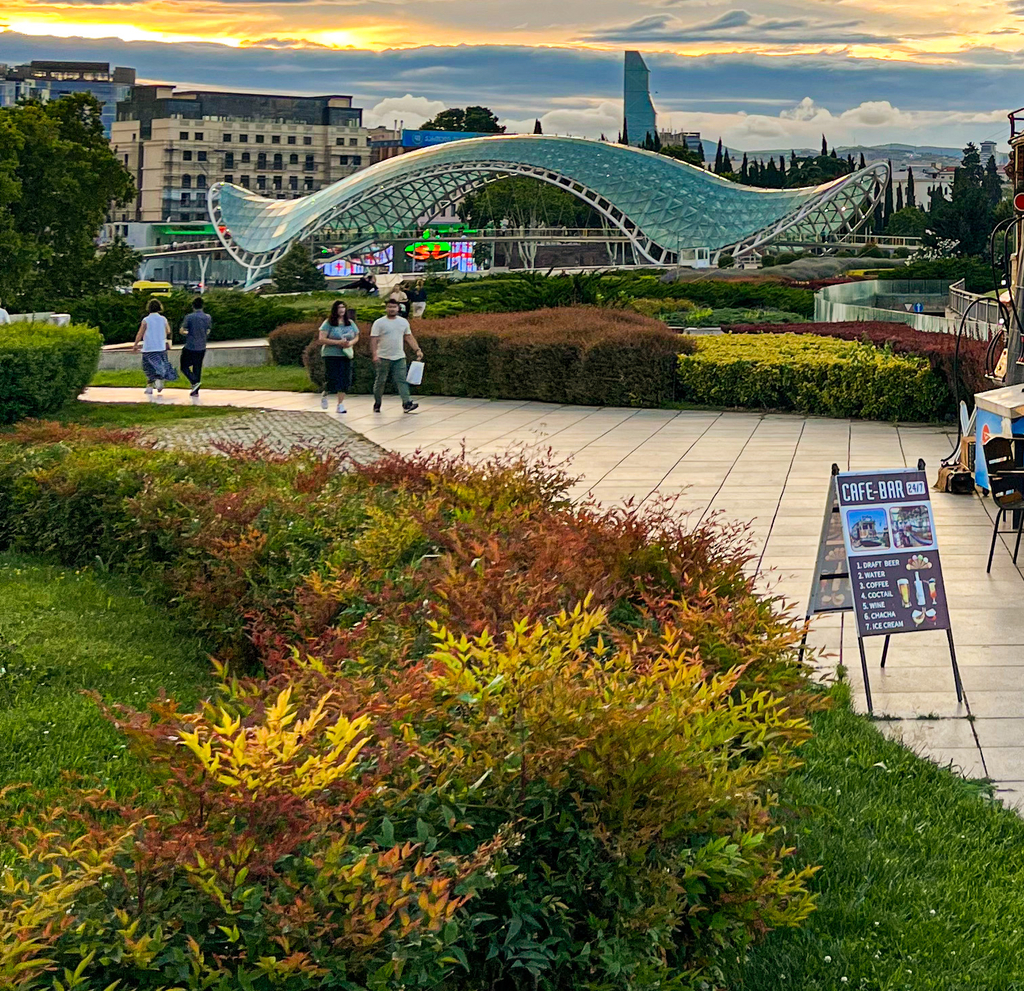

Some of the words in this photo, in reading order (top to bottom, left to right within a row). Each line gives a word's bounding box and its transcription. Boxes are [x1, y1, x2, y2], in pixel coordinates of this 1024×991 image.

[841, 479, 905, 502] CAFE-BAR
[907, 482, 923, 494] 24/7
[863, 560, 882, 569] DRAFT
[883, 559, 900, 567] BEER
[864, 570, 886, 579] WATER
[859, 582, 865, 590] 3.
[866, 580, 889, 589] COFFEE
[867, 590, 893, 599] COCTAIL
[869, 601, 886, 609] WINE
[870, 611, 896, 619] CHACHA
[865, 623, 871, 631] 7.
[872, 621, 883, 630] ICE
[883, 620, 904, 629] CREAM
